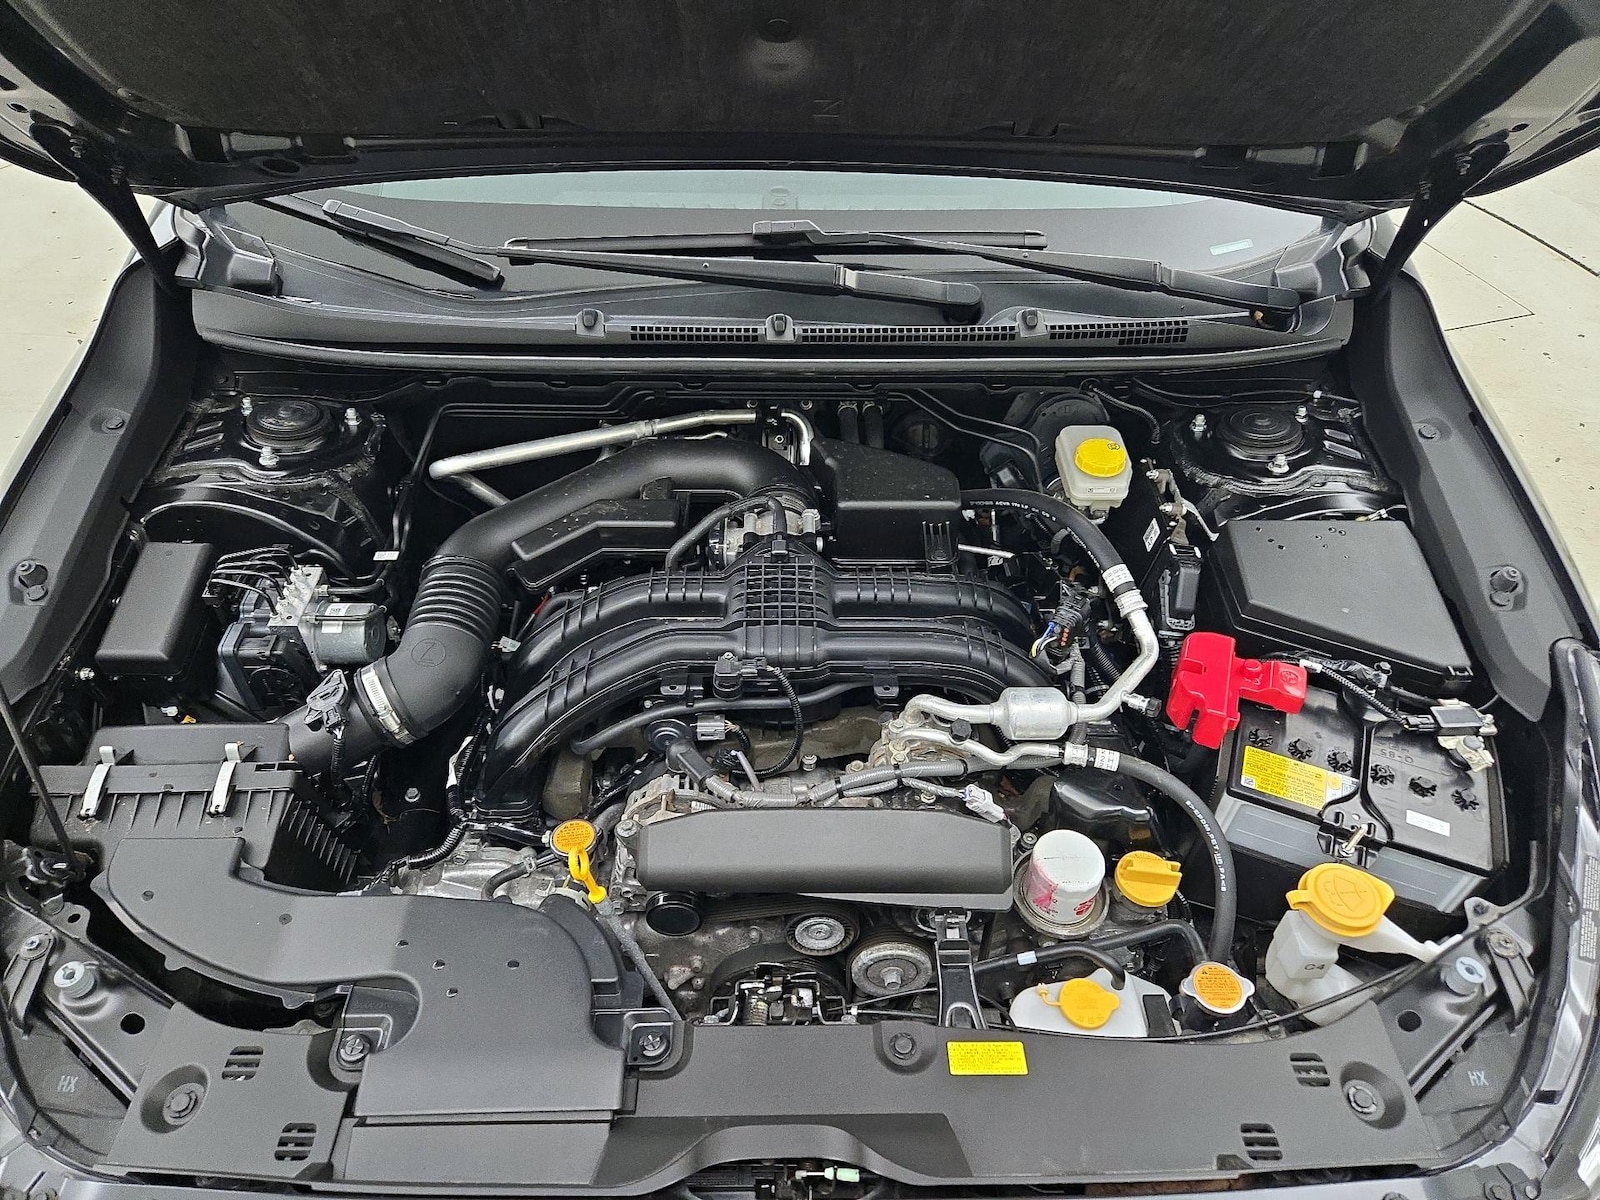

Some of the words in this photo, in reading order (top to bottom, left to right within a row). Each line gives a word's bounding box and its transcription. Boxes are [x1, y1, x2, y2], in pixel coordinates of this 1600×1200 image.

[1304, 963, 1325, 971] C4
[57, 1075, 79, 1093] HX
[1467, 1070, 1489, 1087] HX
